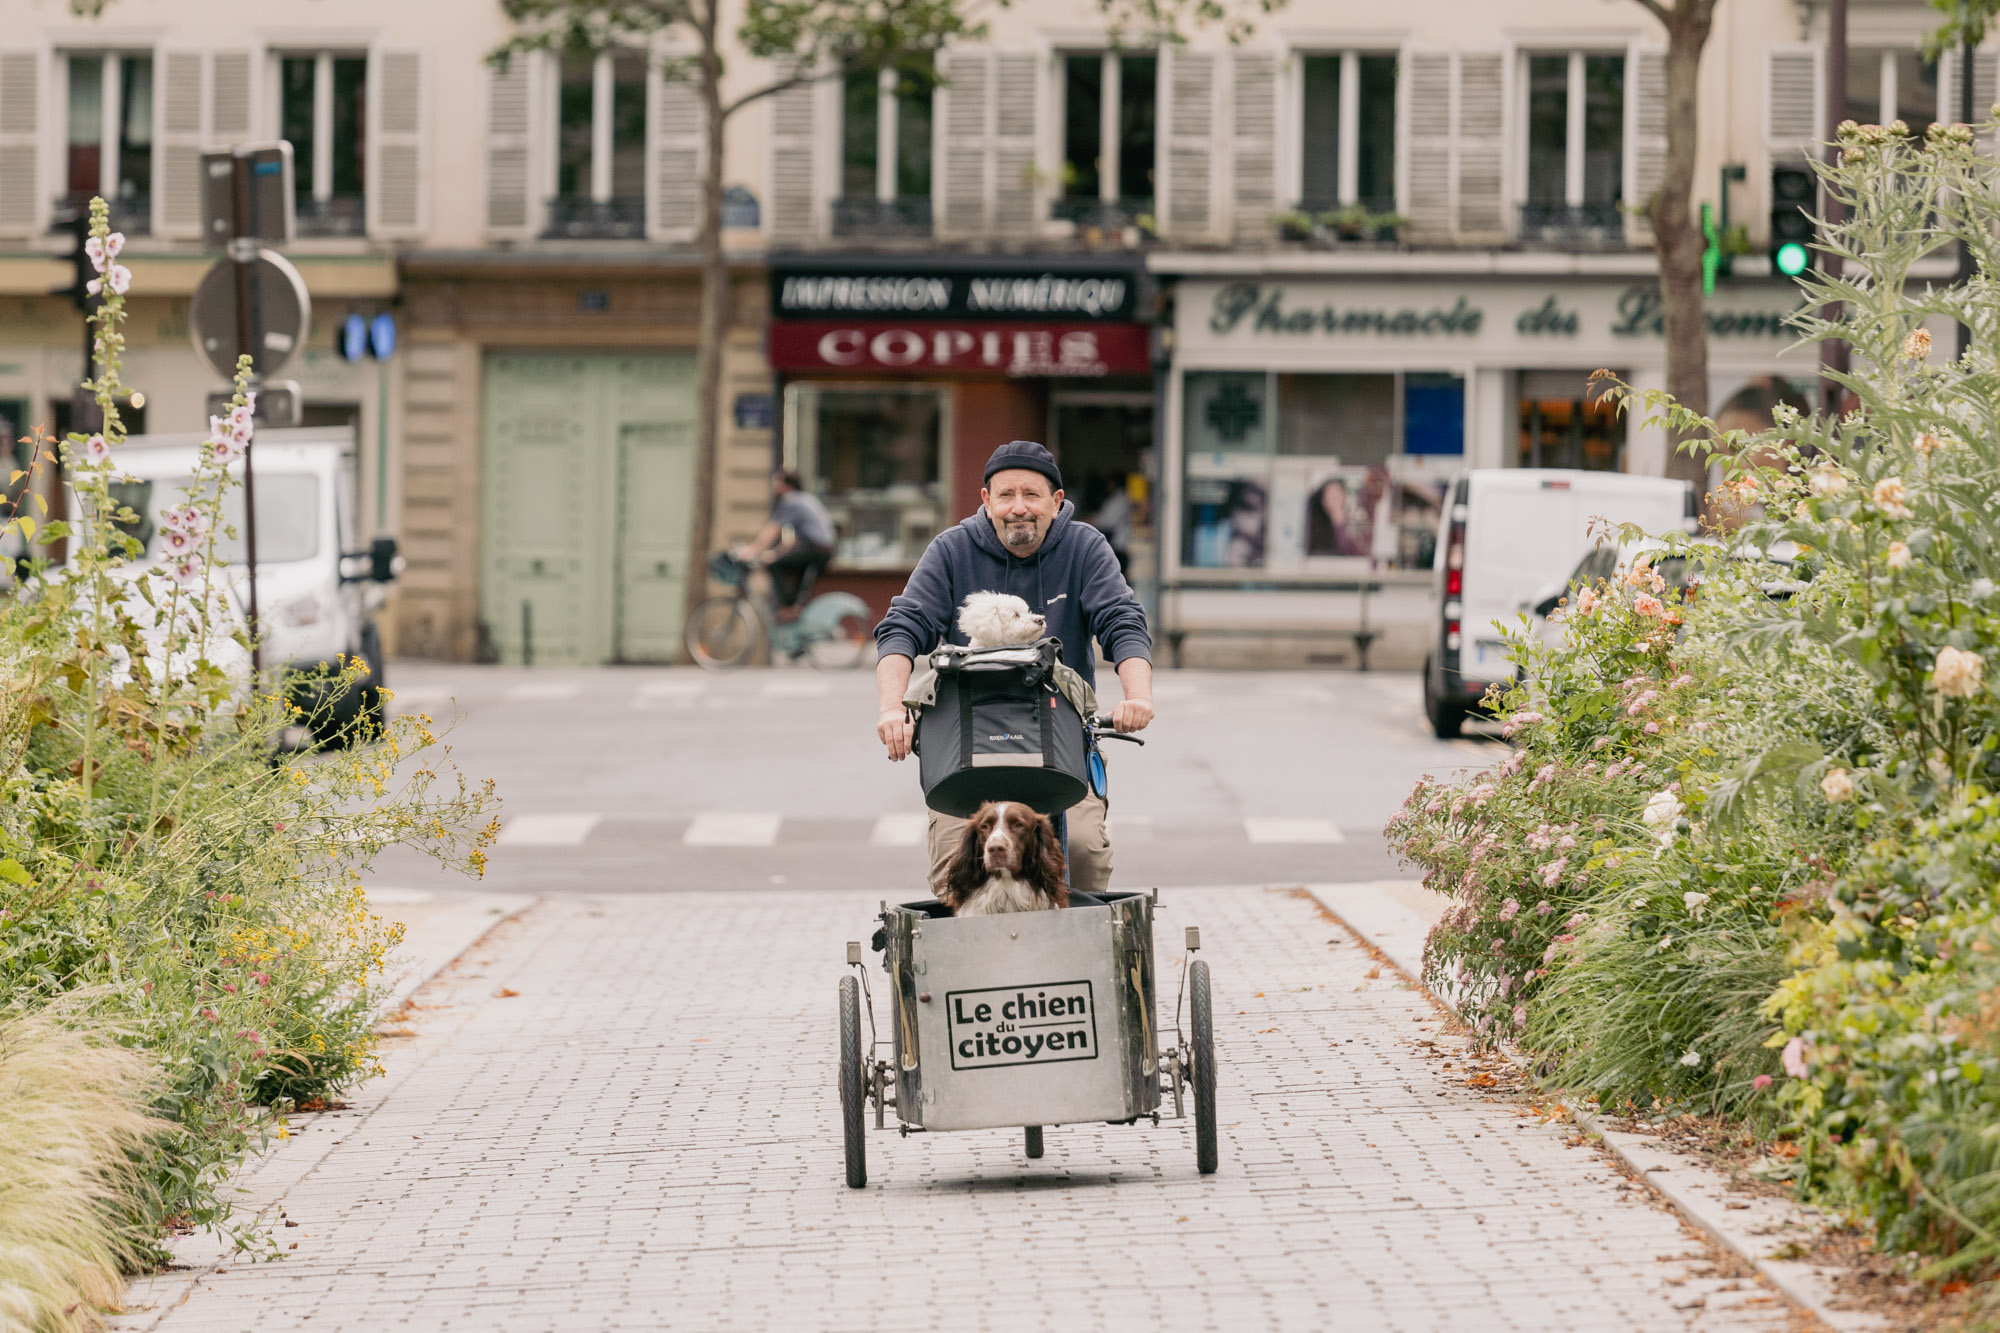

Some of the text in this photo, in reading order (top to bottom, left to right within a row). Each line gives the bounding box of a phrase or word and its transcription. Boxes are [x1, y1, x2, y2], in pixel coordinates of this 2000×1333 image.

[781, 276, 951, 311] IMPRESSION
[1209, 280, 1483, 335] Pharmacie
[1515, 294, 1579, 335] du
[817, 329, 1099, 366] COPIES
[954, 992, 1086, 1025] Le chien
[996, 1021, 1016, 1033] du
[958, 1030, 1088, 1059] citoyen
